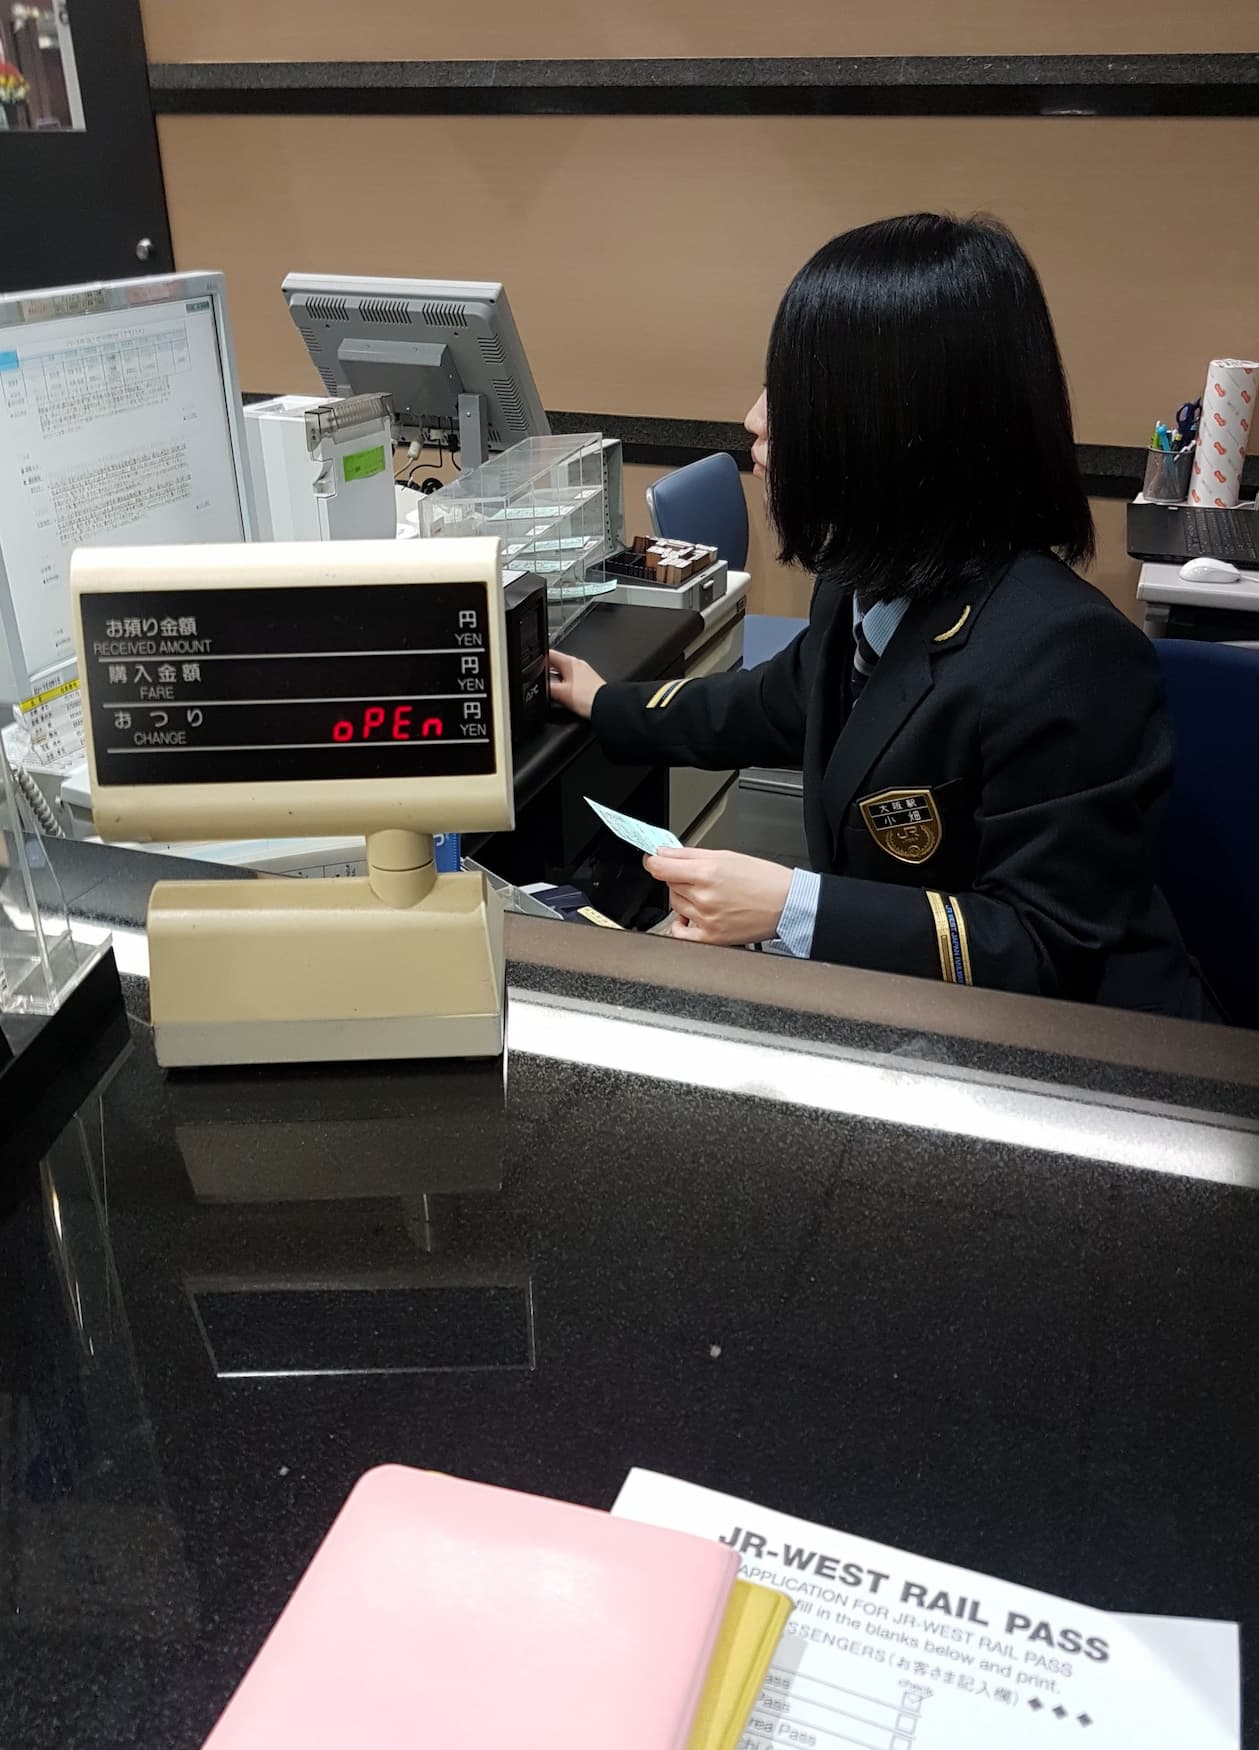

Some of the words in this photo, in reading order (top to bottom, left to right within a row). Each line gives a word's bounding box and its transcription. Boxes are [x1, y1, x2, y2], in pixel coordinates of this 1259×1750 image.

[105, 617, 197, 638] お預り金額
[459, 610, 477, 629] 円
[93, 641, 156, 655] RECEIVED
[159, 639, 212, 654] AMOUNT
[455, 632, 482, 646] YEN
[108, 663, 201, 684] 購入金額
[461, 656, 479, 674] 円
[140, 686, 175, 699] FARE
[457, 678, 484, 691] YEN
[463, 702, 481, 720] 円
[133, 731, 187, 745] CHANGE
[460, 723, 487, 736] YEN
[719, 1526, 890, 1595] JR-WEST
[900, 1580, 989, 1627] RAIL
[1005, 1610, 1110, 1664] PASS
[739, 1564, 849, 1607] APPLICATION
[852, 1598, 889, 1619] FOR
[893, 1612, 974, 1644] JR-WEST
[978, 1636, 1018, 1661] RAIL
[1024, 1649, 1073, 1678] PASS
[785, 1621, 887, 1664] SSENGERS
[816, 1606, 831, 1621] in
[835, 1612, 861, 1630] the
[865, 1621, 919, 1649] blanks
[924, 1639, 975, 1665] below
[979, 1657, 1012, 1678] and
[1016, 1670, 1061, 1695] print.
